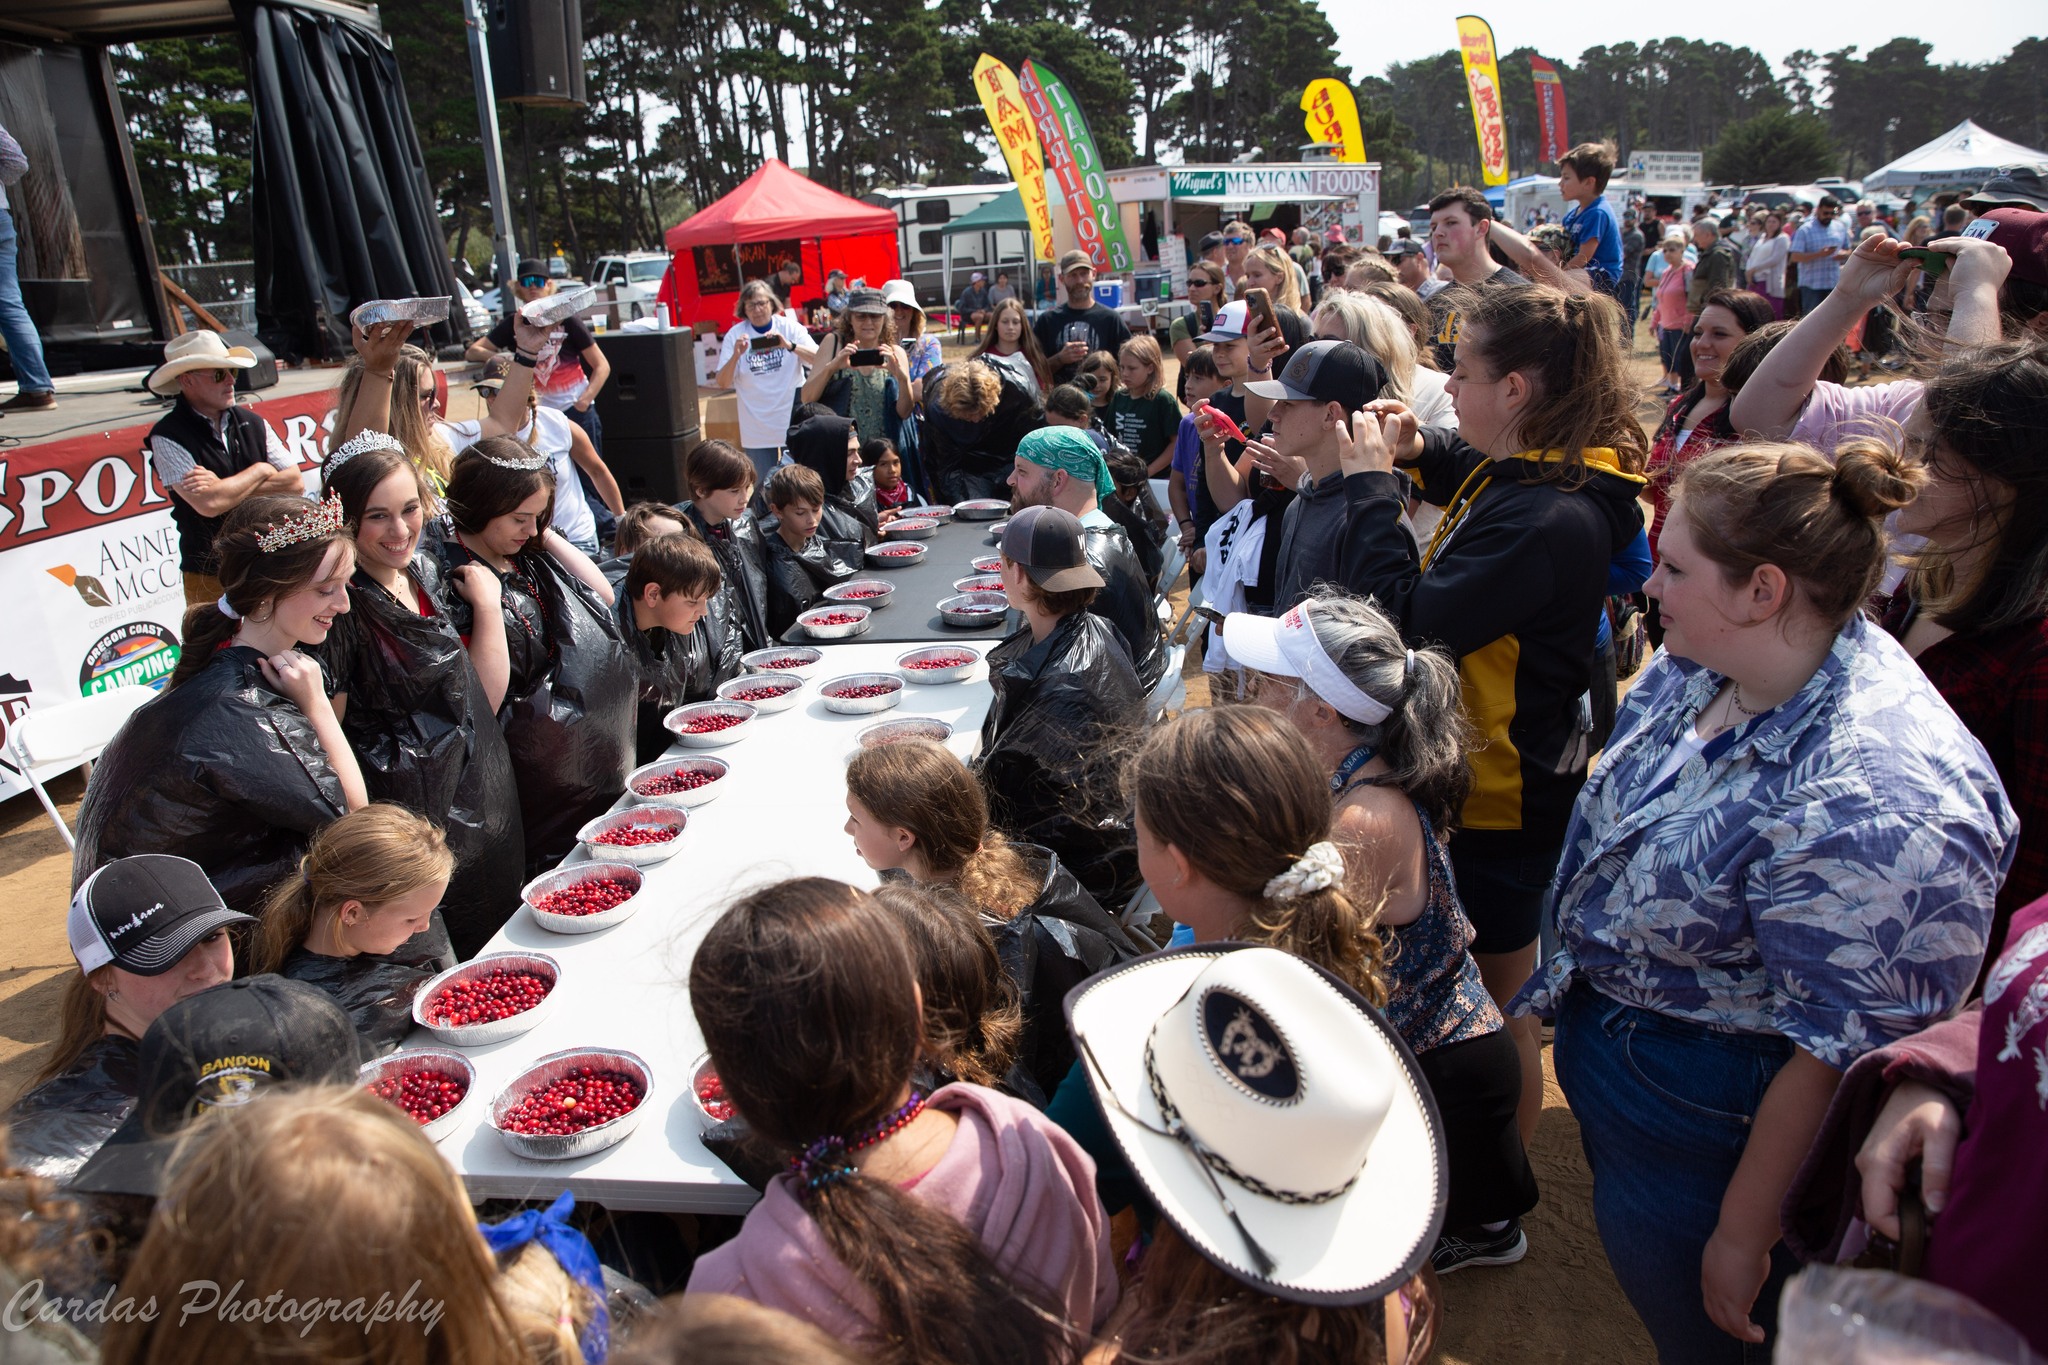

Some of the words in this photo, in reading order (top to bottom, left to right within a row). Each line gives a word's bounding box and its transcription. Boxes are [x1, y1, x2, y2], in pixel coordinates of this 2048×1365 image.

[1172, 171, 1223, 194] Miguel's
[1226, 170, 1311, 194] MEXICAN
[1316, 170, 1373, 193] FOODS
[88, 607, 127, 630] CERTIFIED
[86, 628, 127, 667] OREGON
[129, 624, 164, 637] COAST
[90, 648, 177, 696] CAMPING
[201, 1055, 271, 1077] BANDON
